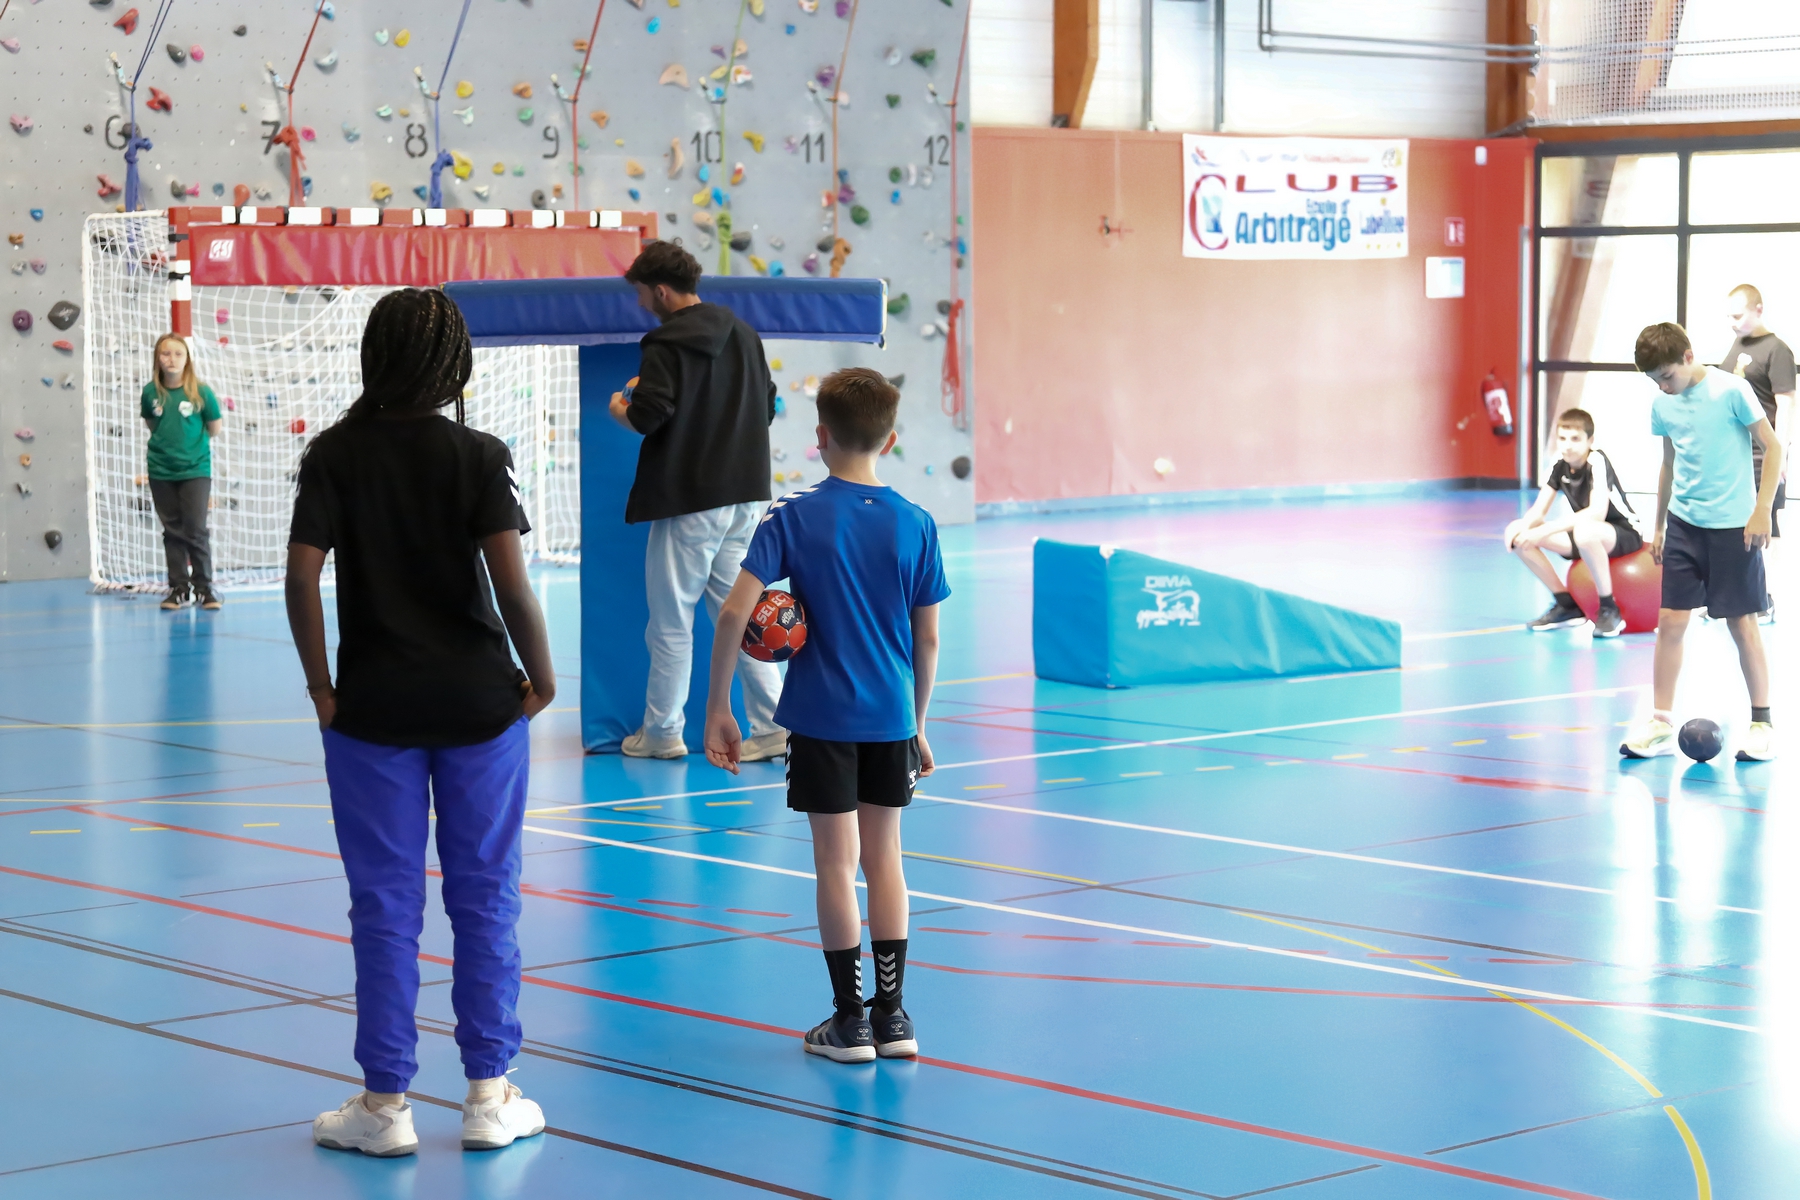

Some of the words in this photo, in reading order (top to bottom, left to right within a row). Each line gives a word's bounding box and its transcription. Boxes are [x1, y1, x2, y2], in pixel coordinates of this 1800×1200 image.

[261, 120, 281, 155] 7
[404, 122, 428, 158] 8
[543, 125, 560, 159] 9
[690, 130, 722, 163] 10
[800, 132, 825, 164] 11
[923, 134, 950, 167] 12
[1235, 211, 1351, 252] Arbitrage
